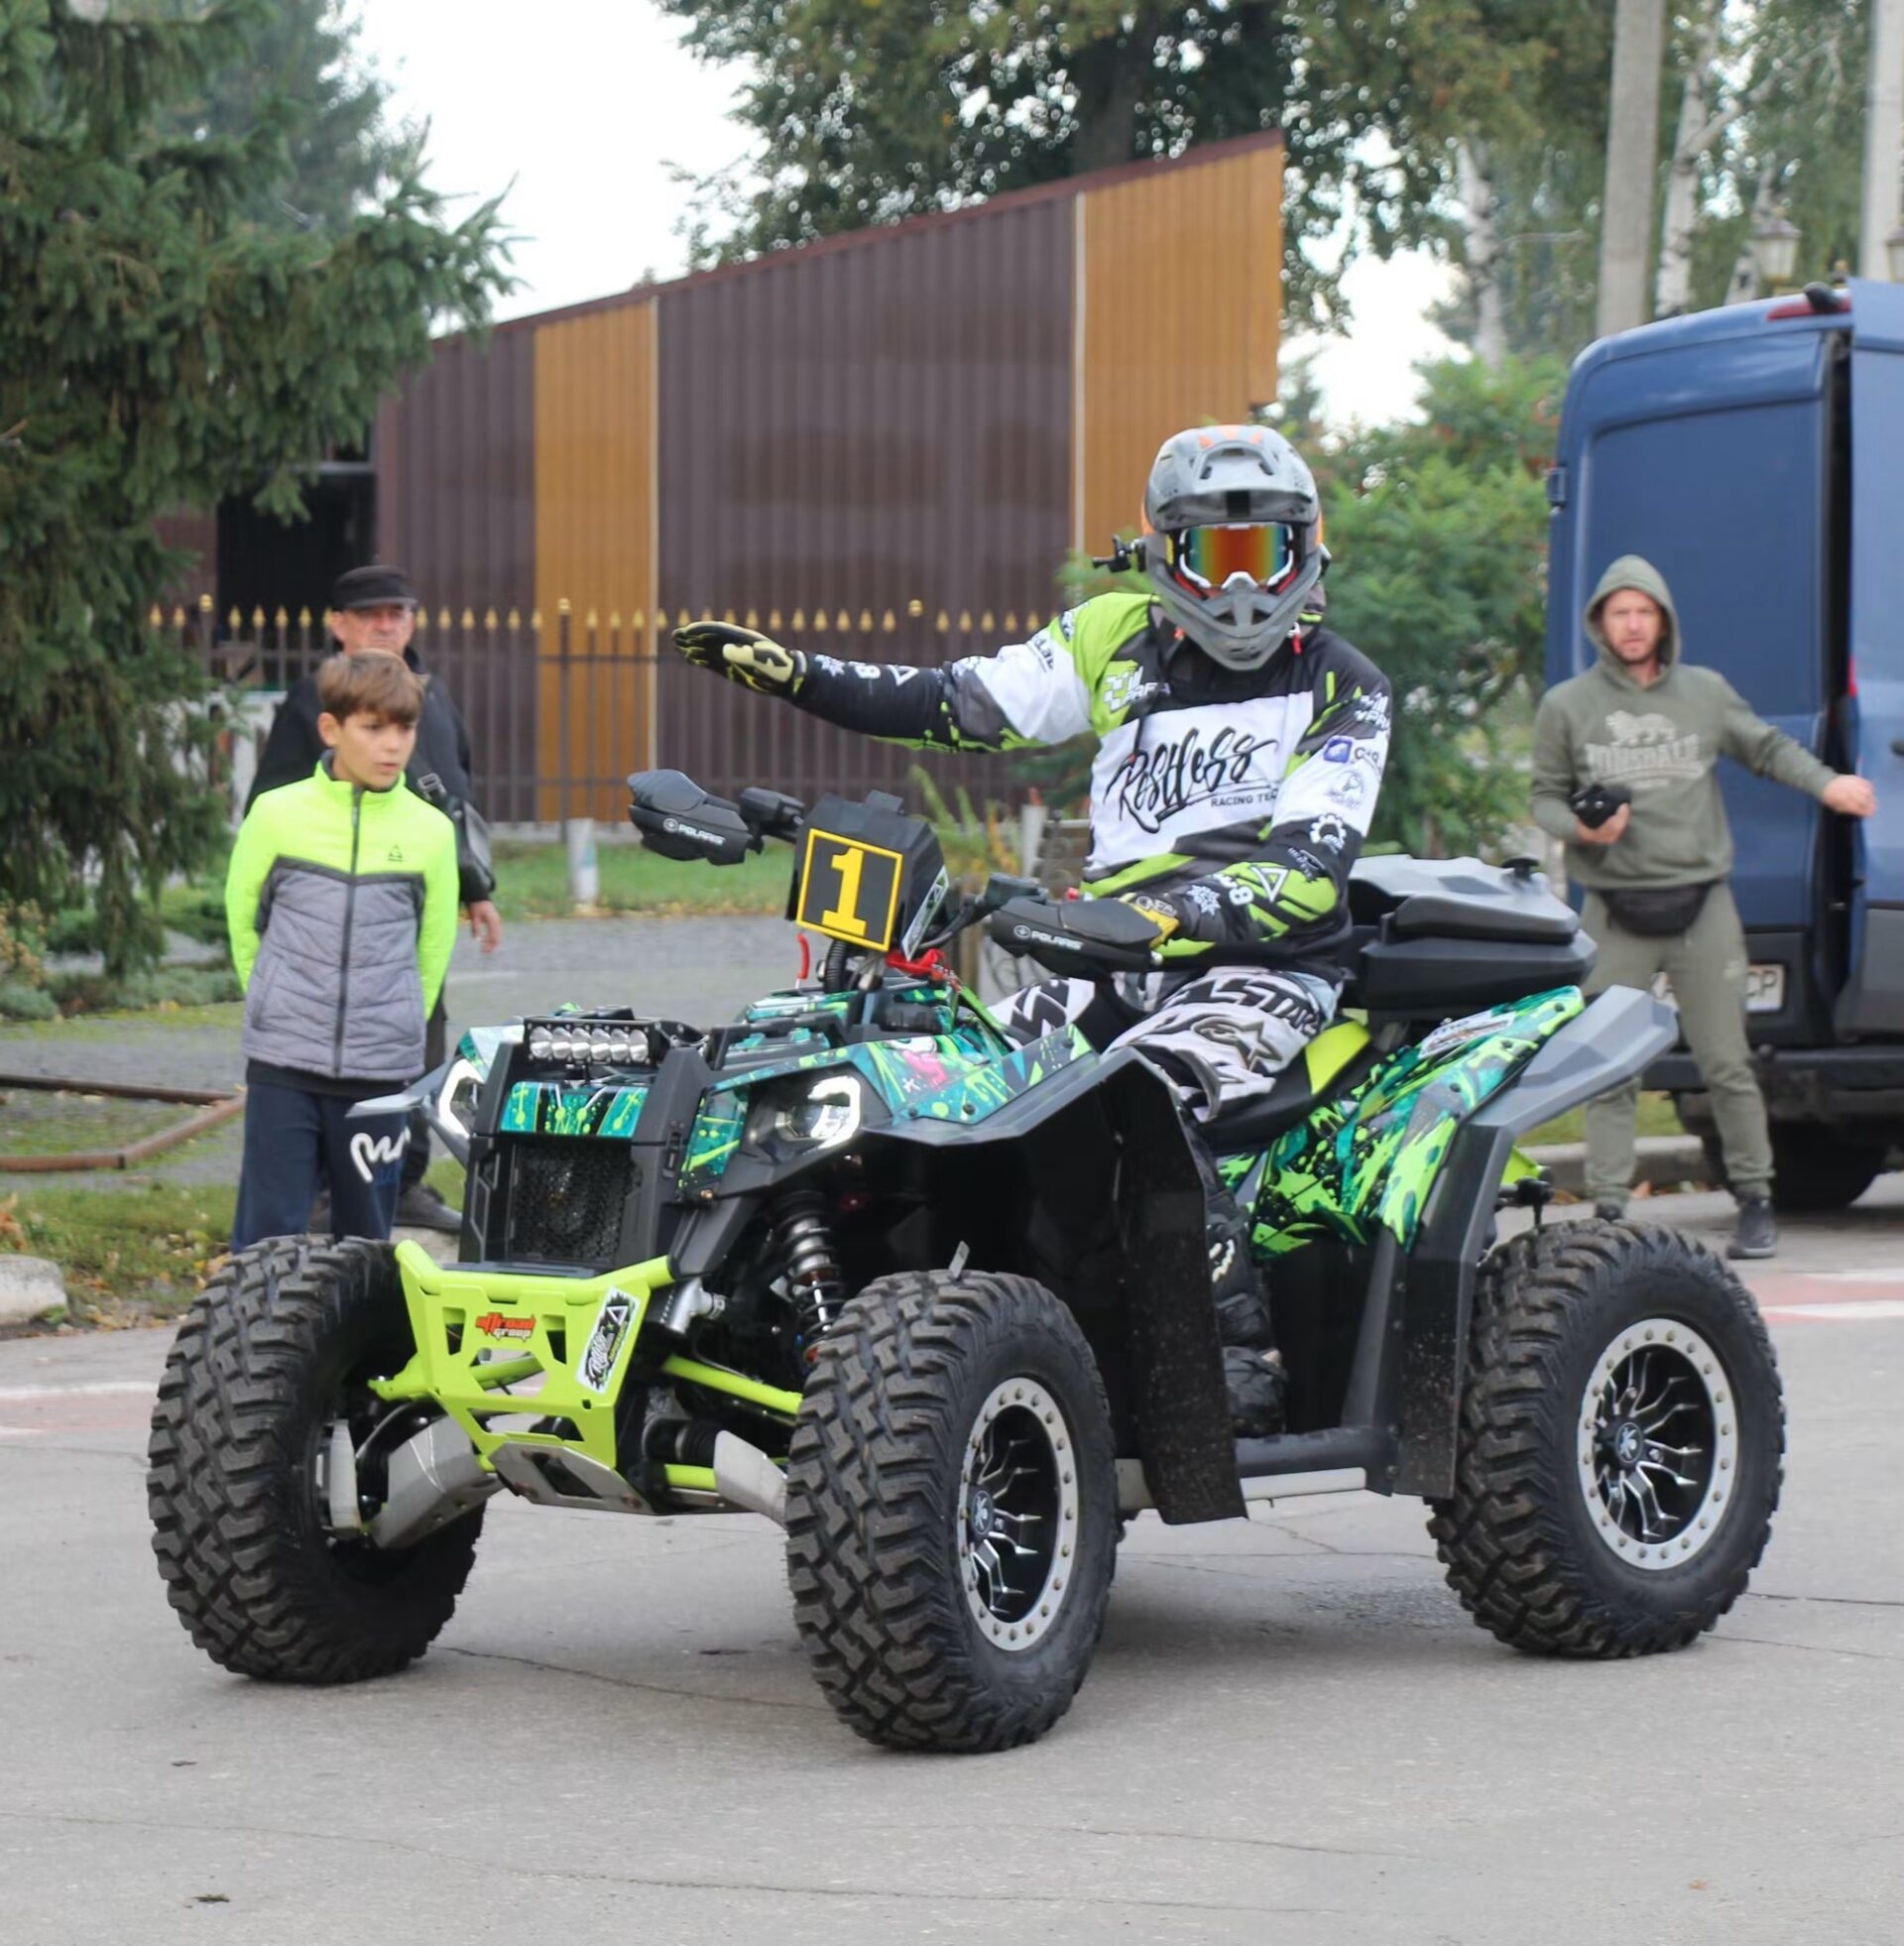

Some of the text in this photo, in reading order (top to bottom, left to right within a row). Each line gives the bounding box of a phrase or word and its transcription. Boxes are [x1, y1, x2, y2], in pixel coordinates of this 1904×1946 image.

[1210, 788, 1279, 807] RACING TEA
[677, 823, 726, 846] POLARIS
[821, 846, 868, 936] 1
[1030, 929, 1085, 951] POLARIS
